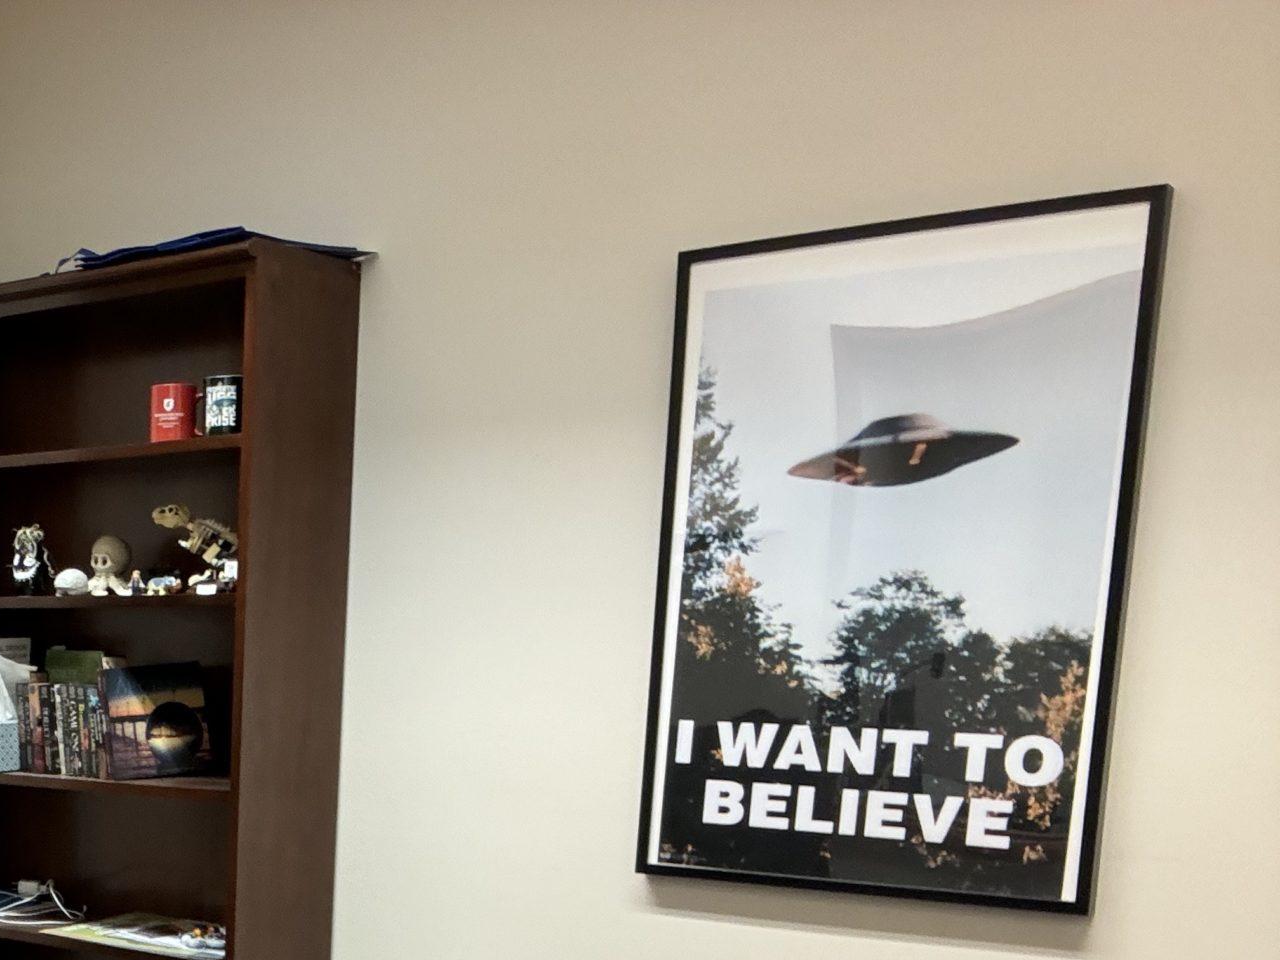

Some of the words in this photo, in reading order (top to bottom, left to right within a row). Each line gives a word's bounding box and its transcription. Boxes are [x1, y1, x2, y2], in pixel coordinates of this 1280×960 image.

[675, 719, 695, 764] I
[717, 720, 929, 778] WANT
[953, 732, 1065, 787] TO
[702, 779, 1013, 850] BELIEVE
